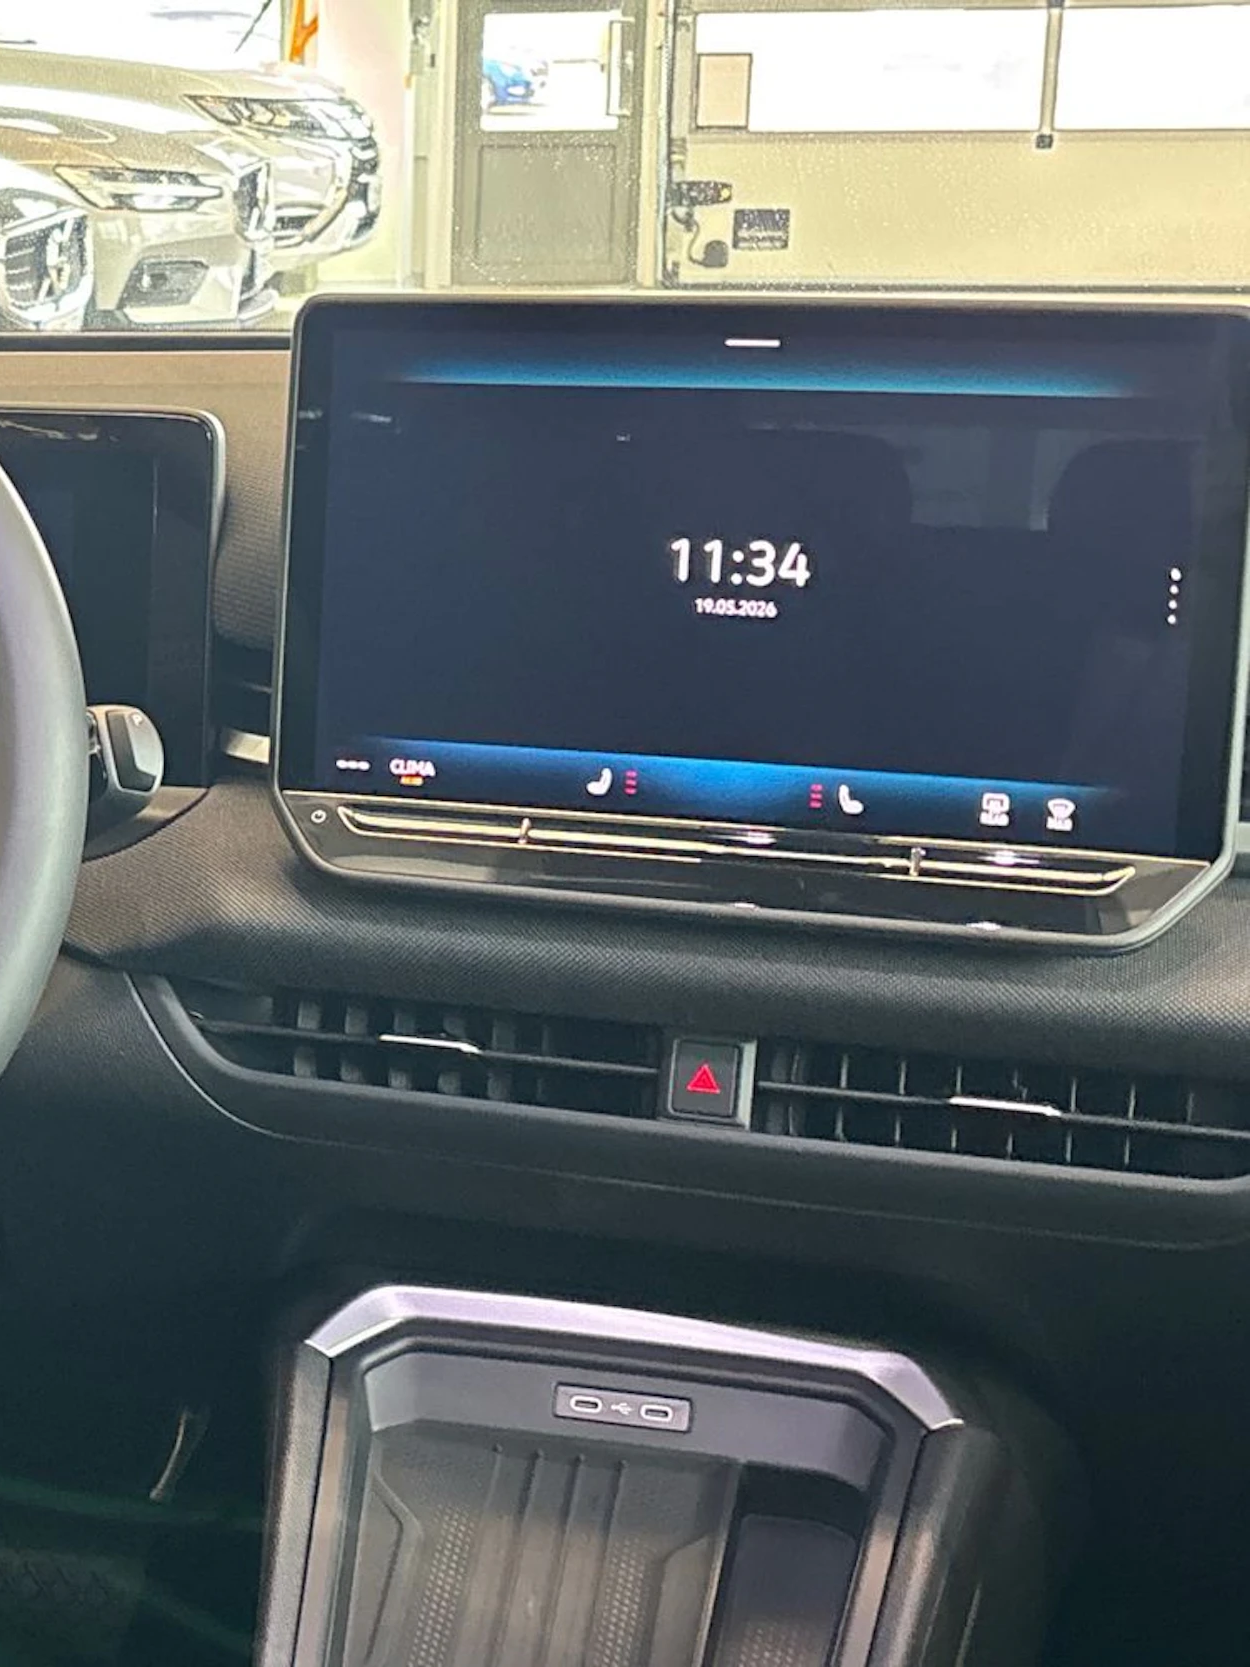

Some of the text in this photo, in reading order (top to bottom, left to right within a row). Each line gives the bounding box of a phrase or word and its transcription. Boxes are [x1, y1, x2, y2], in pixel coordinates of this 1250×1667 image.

[670, 538, 811, 588] 11:34
[694, 598, 779, 619] 19.05.2026
[389, 758, 437, 777] CLIMA
